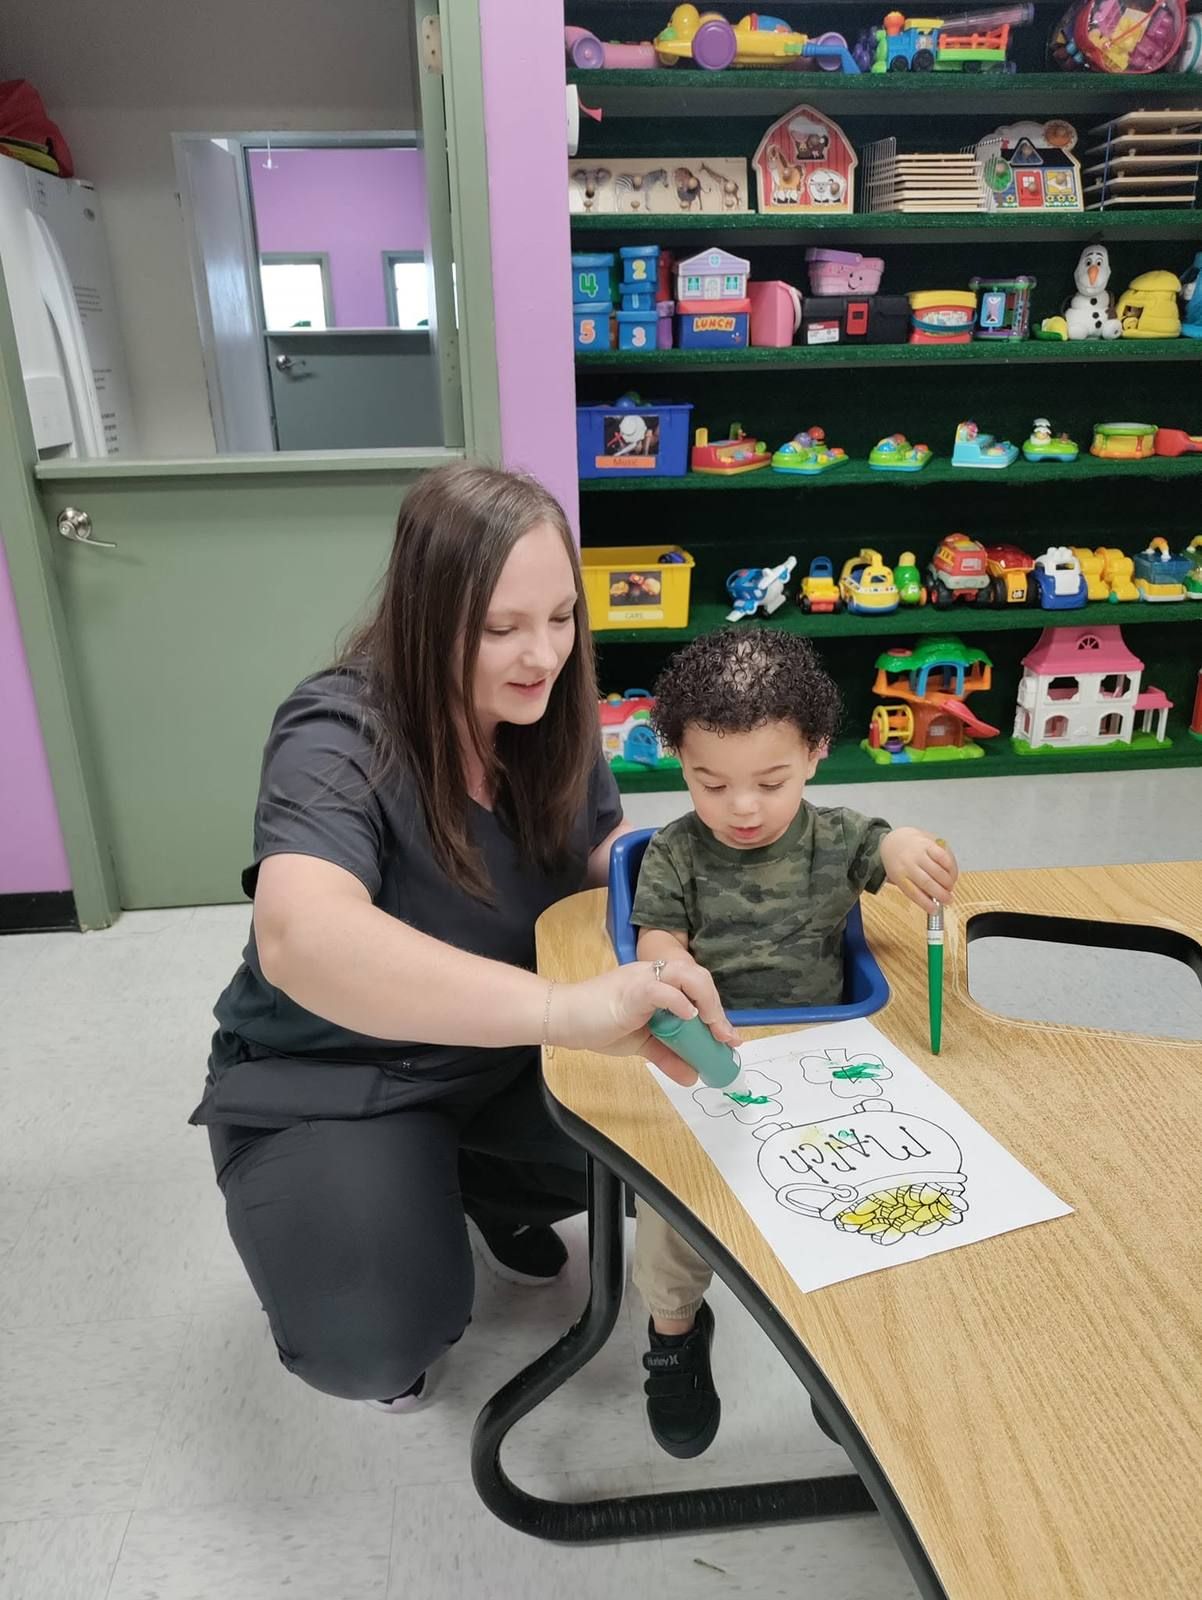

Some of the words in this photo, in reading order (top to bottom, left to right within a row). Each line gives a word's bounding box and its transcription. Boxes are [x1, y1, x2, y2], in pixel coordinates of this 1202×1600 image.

[632, 259, 647, 280] 2
[580, 273, 598, 297] 4
[579, 320, 596, 343] 5
[695, 318, 734, 330] LUNCH
[632, 326, 646, 347] 3
